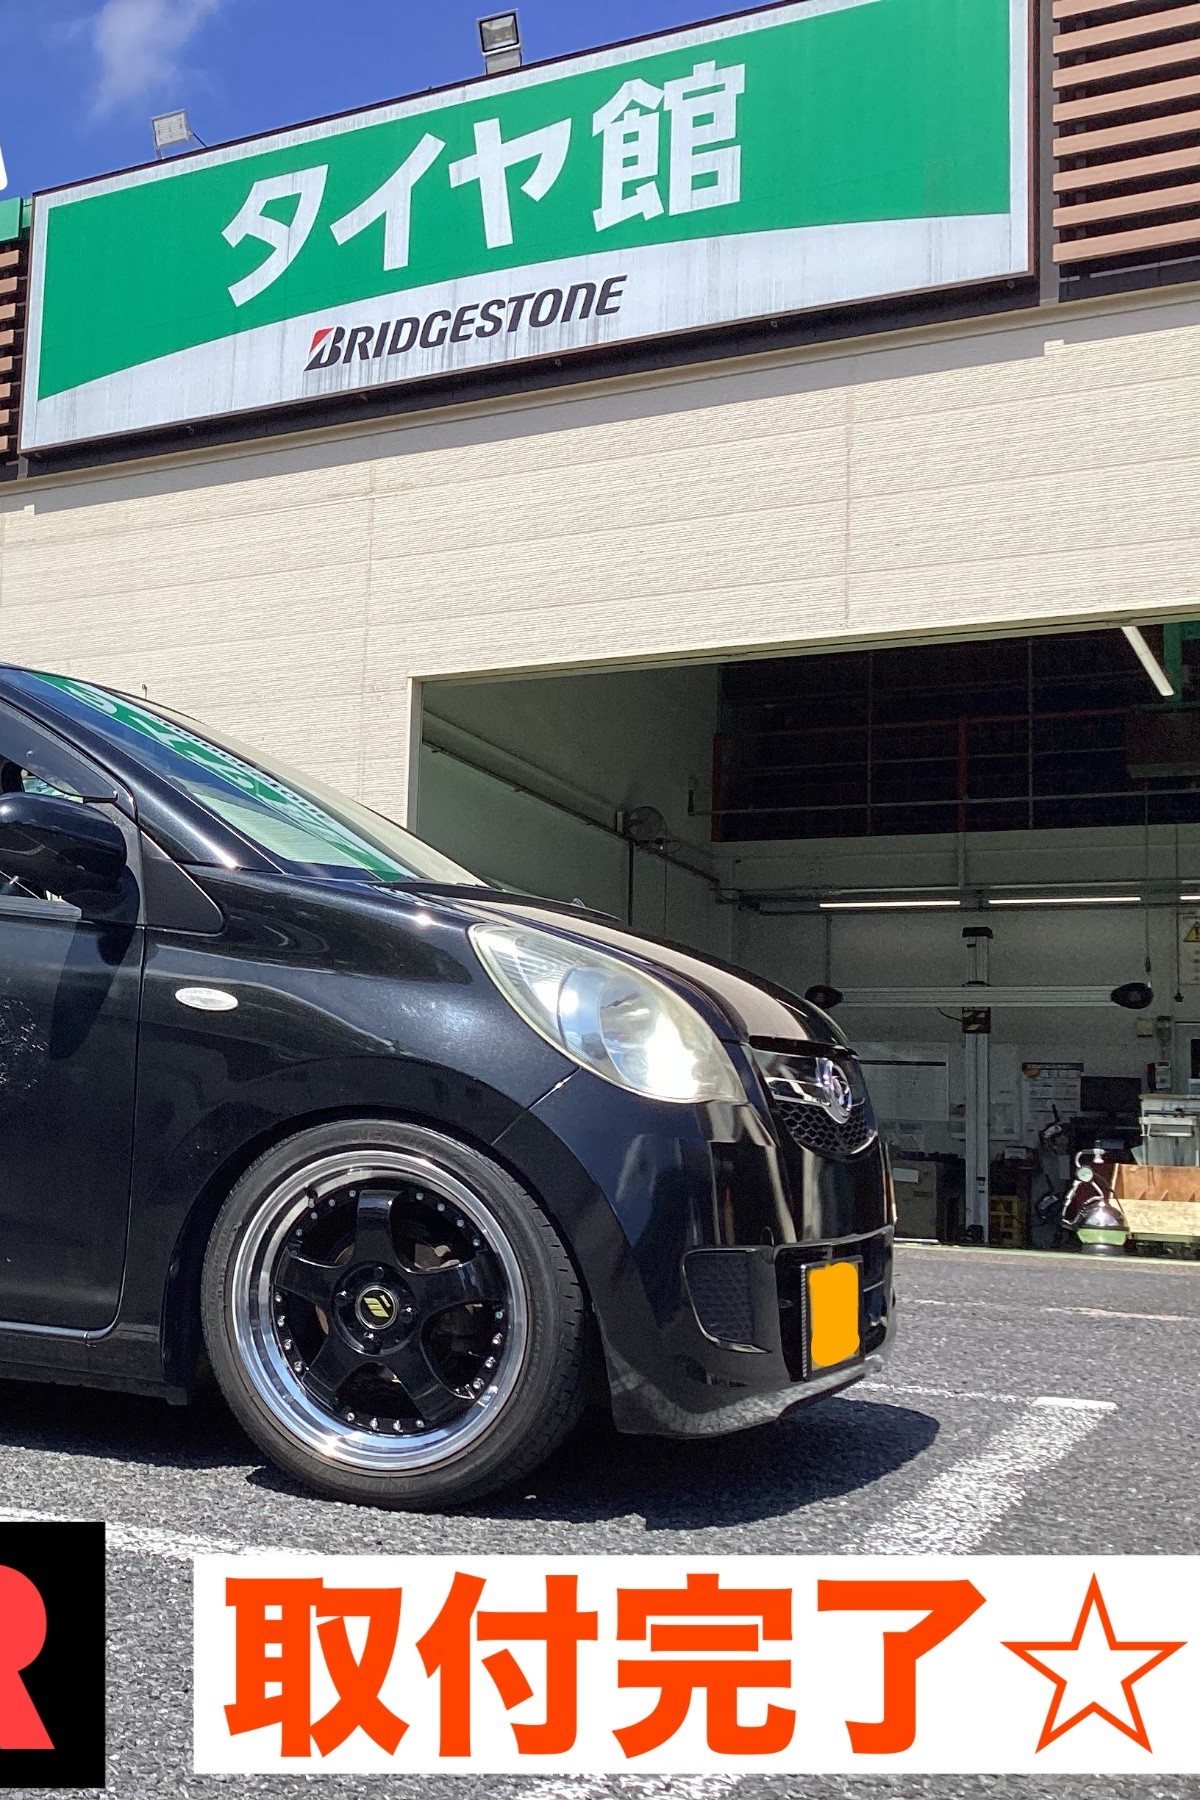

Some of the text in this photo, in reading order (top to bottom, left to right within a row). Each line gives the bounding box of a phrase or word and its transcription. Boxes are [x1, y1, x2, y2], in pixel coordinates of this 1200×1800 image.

[222, 60, 747, 308] タイヤ館
[304, 275, 628, 372] BRIDGESTONE
